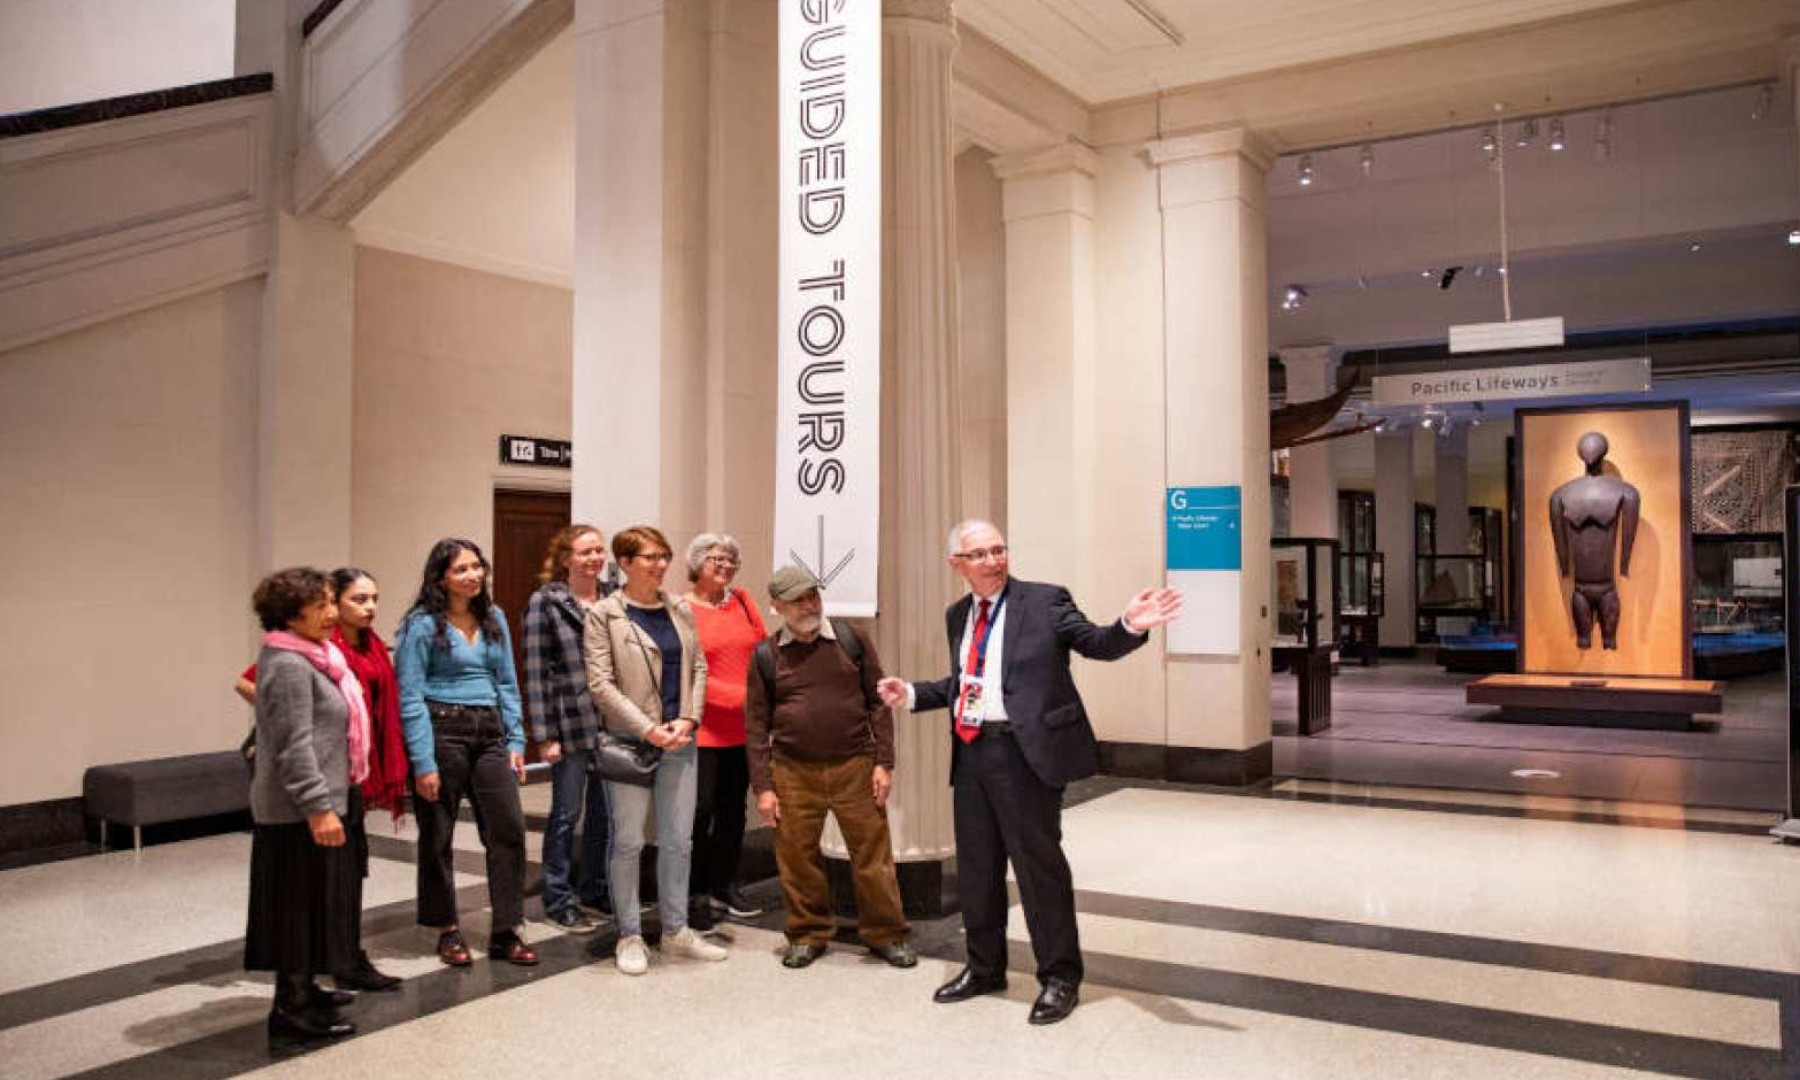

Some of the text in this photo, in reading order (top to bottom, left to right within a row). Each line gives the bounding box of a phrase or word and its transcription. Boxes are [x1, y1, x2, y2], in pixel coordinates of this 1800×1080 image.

[799, 259, 845, 496] TOURS
[1411, 381, 1470, 396] Pacific
[1476, 374, 1558, 391] Lifeways
[1171, 490, 1187, 509] G
